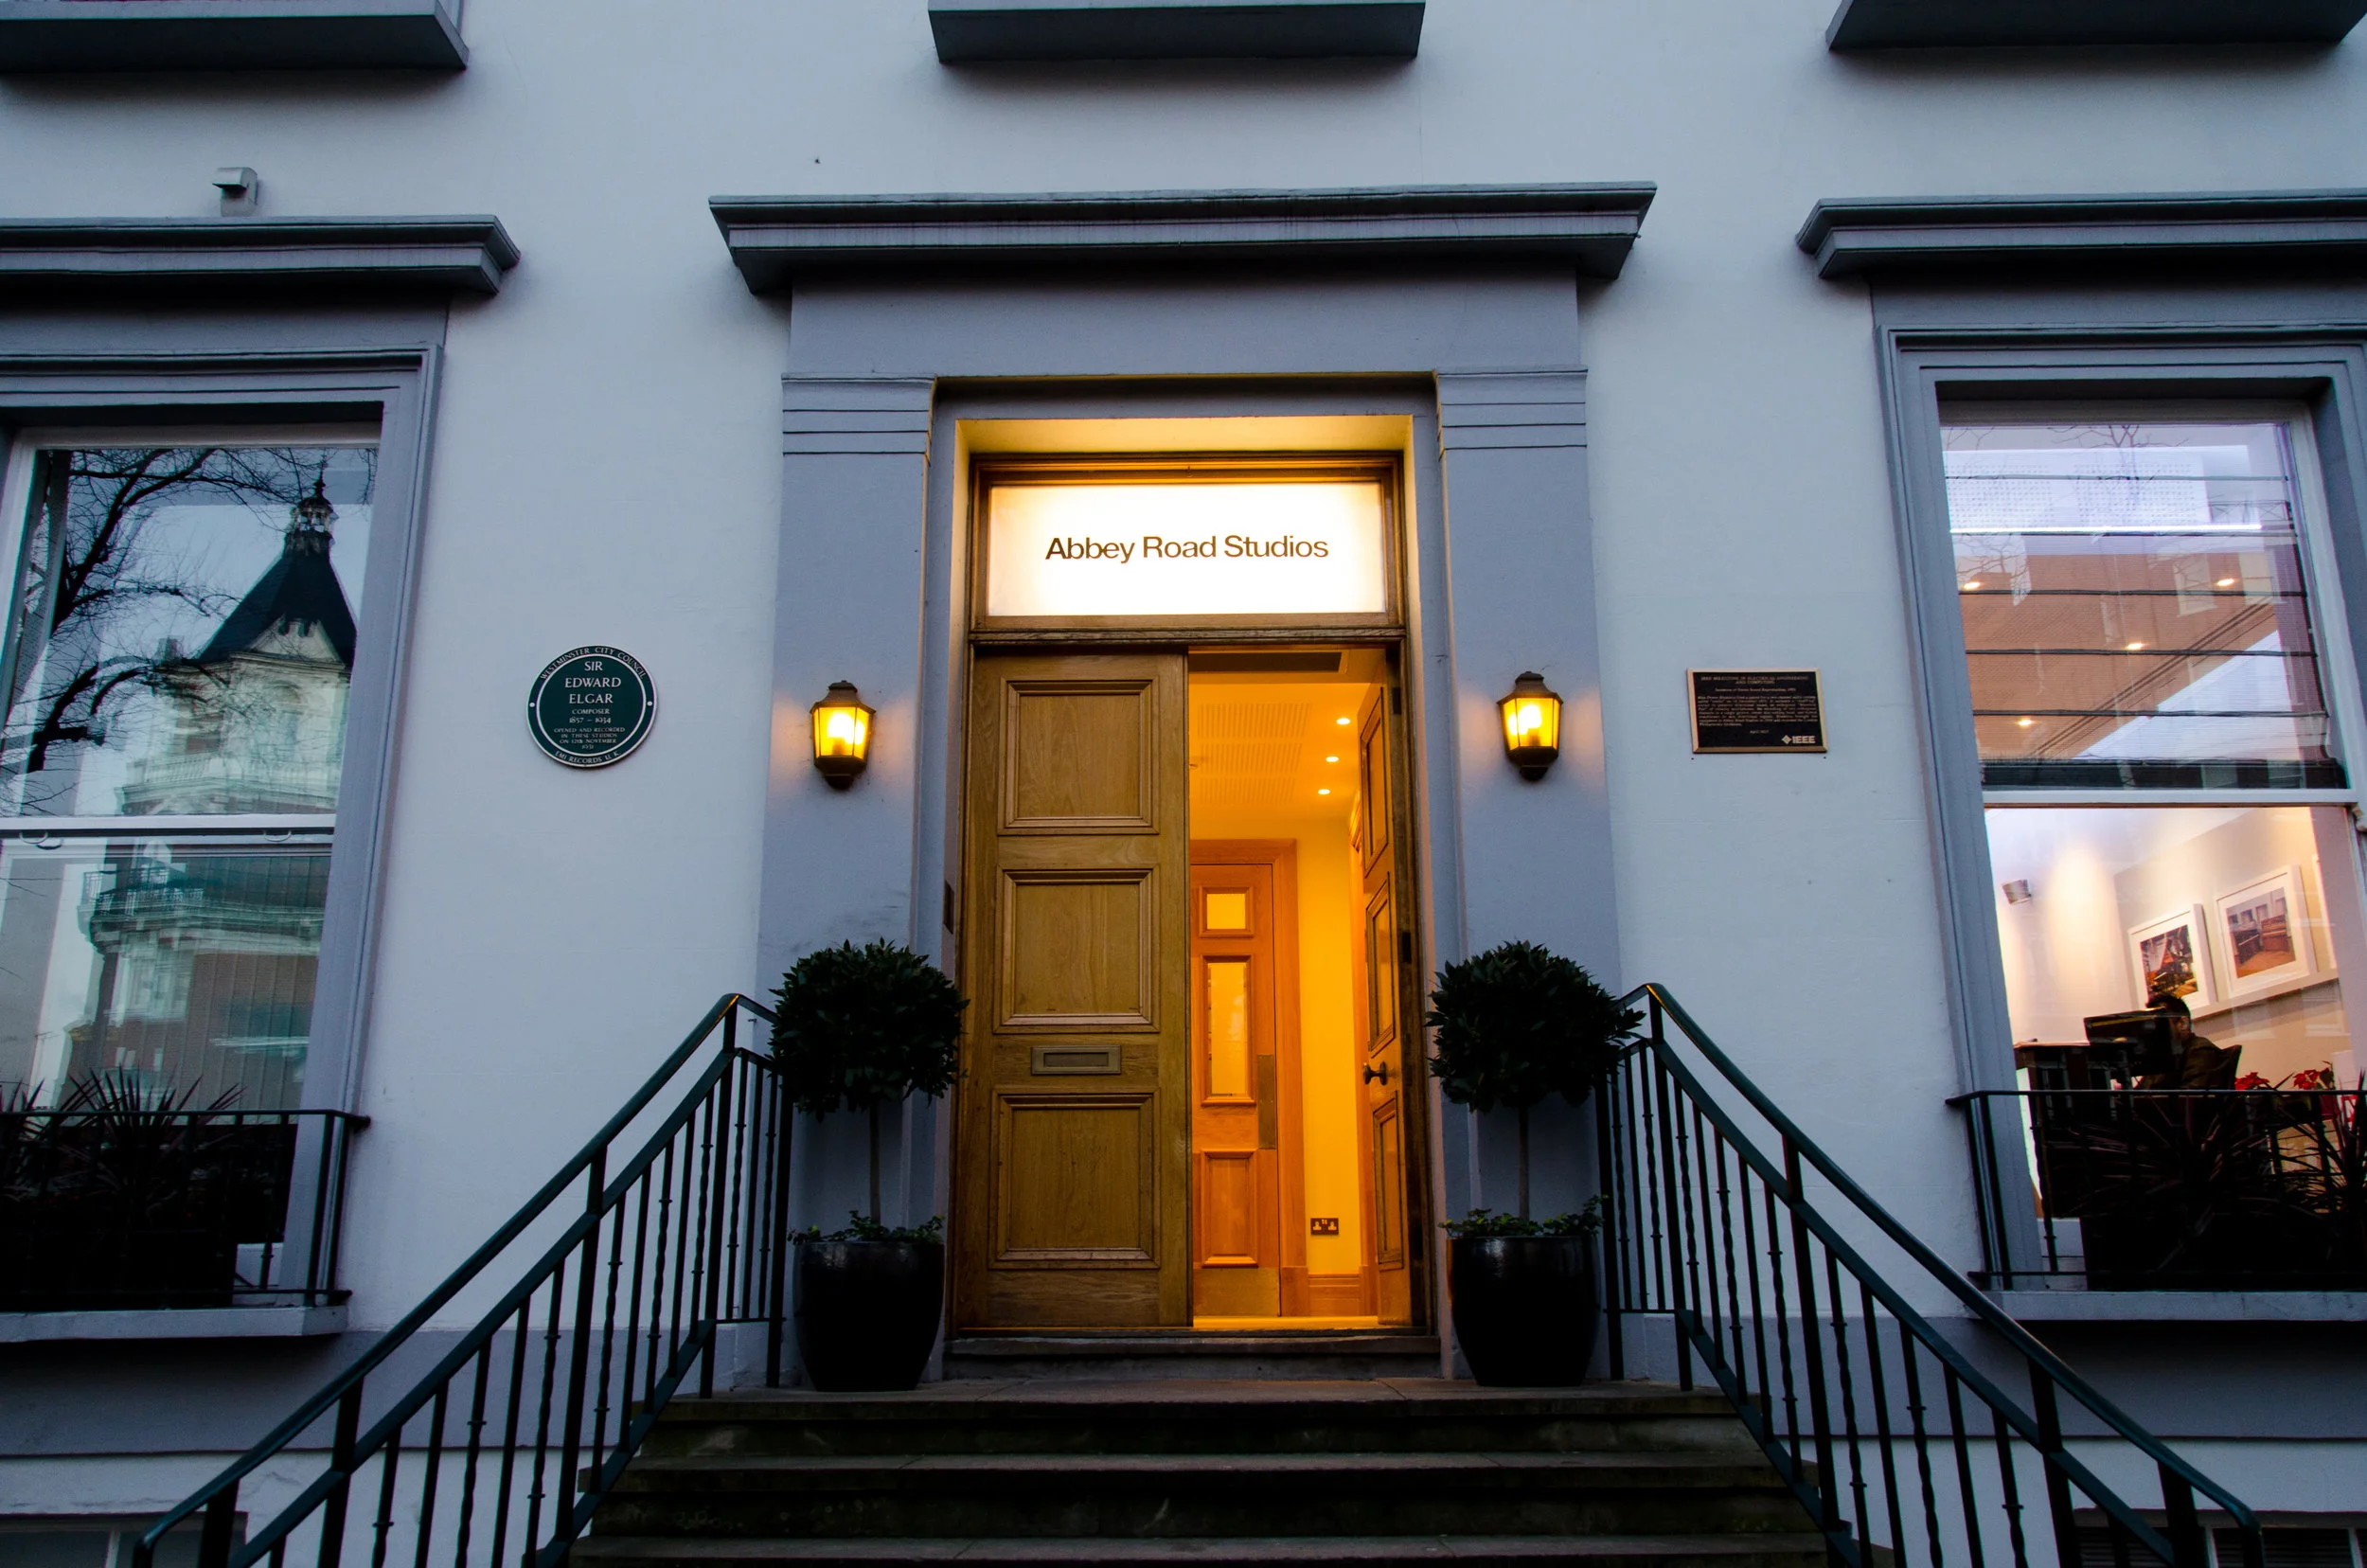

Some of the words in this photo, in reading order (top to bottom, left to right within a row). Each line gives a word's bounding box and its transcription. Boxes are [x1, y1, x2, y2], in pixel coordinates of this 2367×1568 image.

[1045, 536, 1135, 563] Abbey
[1143, 535, 1217, 559] Road
[1224, 534, 1329, 558] Studios
[540, 648, 590, 680] WESTMINSTER
[595, 647, 615, 655] CITY
[617, 652, 647, 680] COUNCIL
[584, 661, 603, 671] SIR
[564, 677, 621, 687] EDWARD
[569, 693, 614, 704] ELGAR
[1792, 735, 1816, 744] IEEE
[555, 750, 567, 760] EMI
[568, 756, 603, 764] RECORDS
